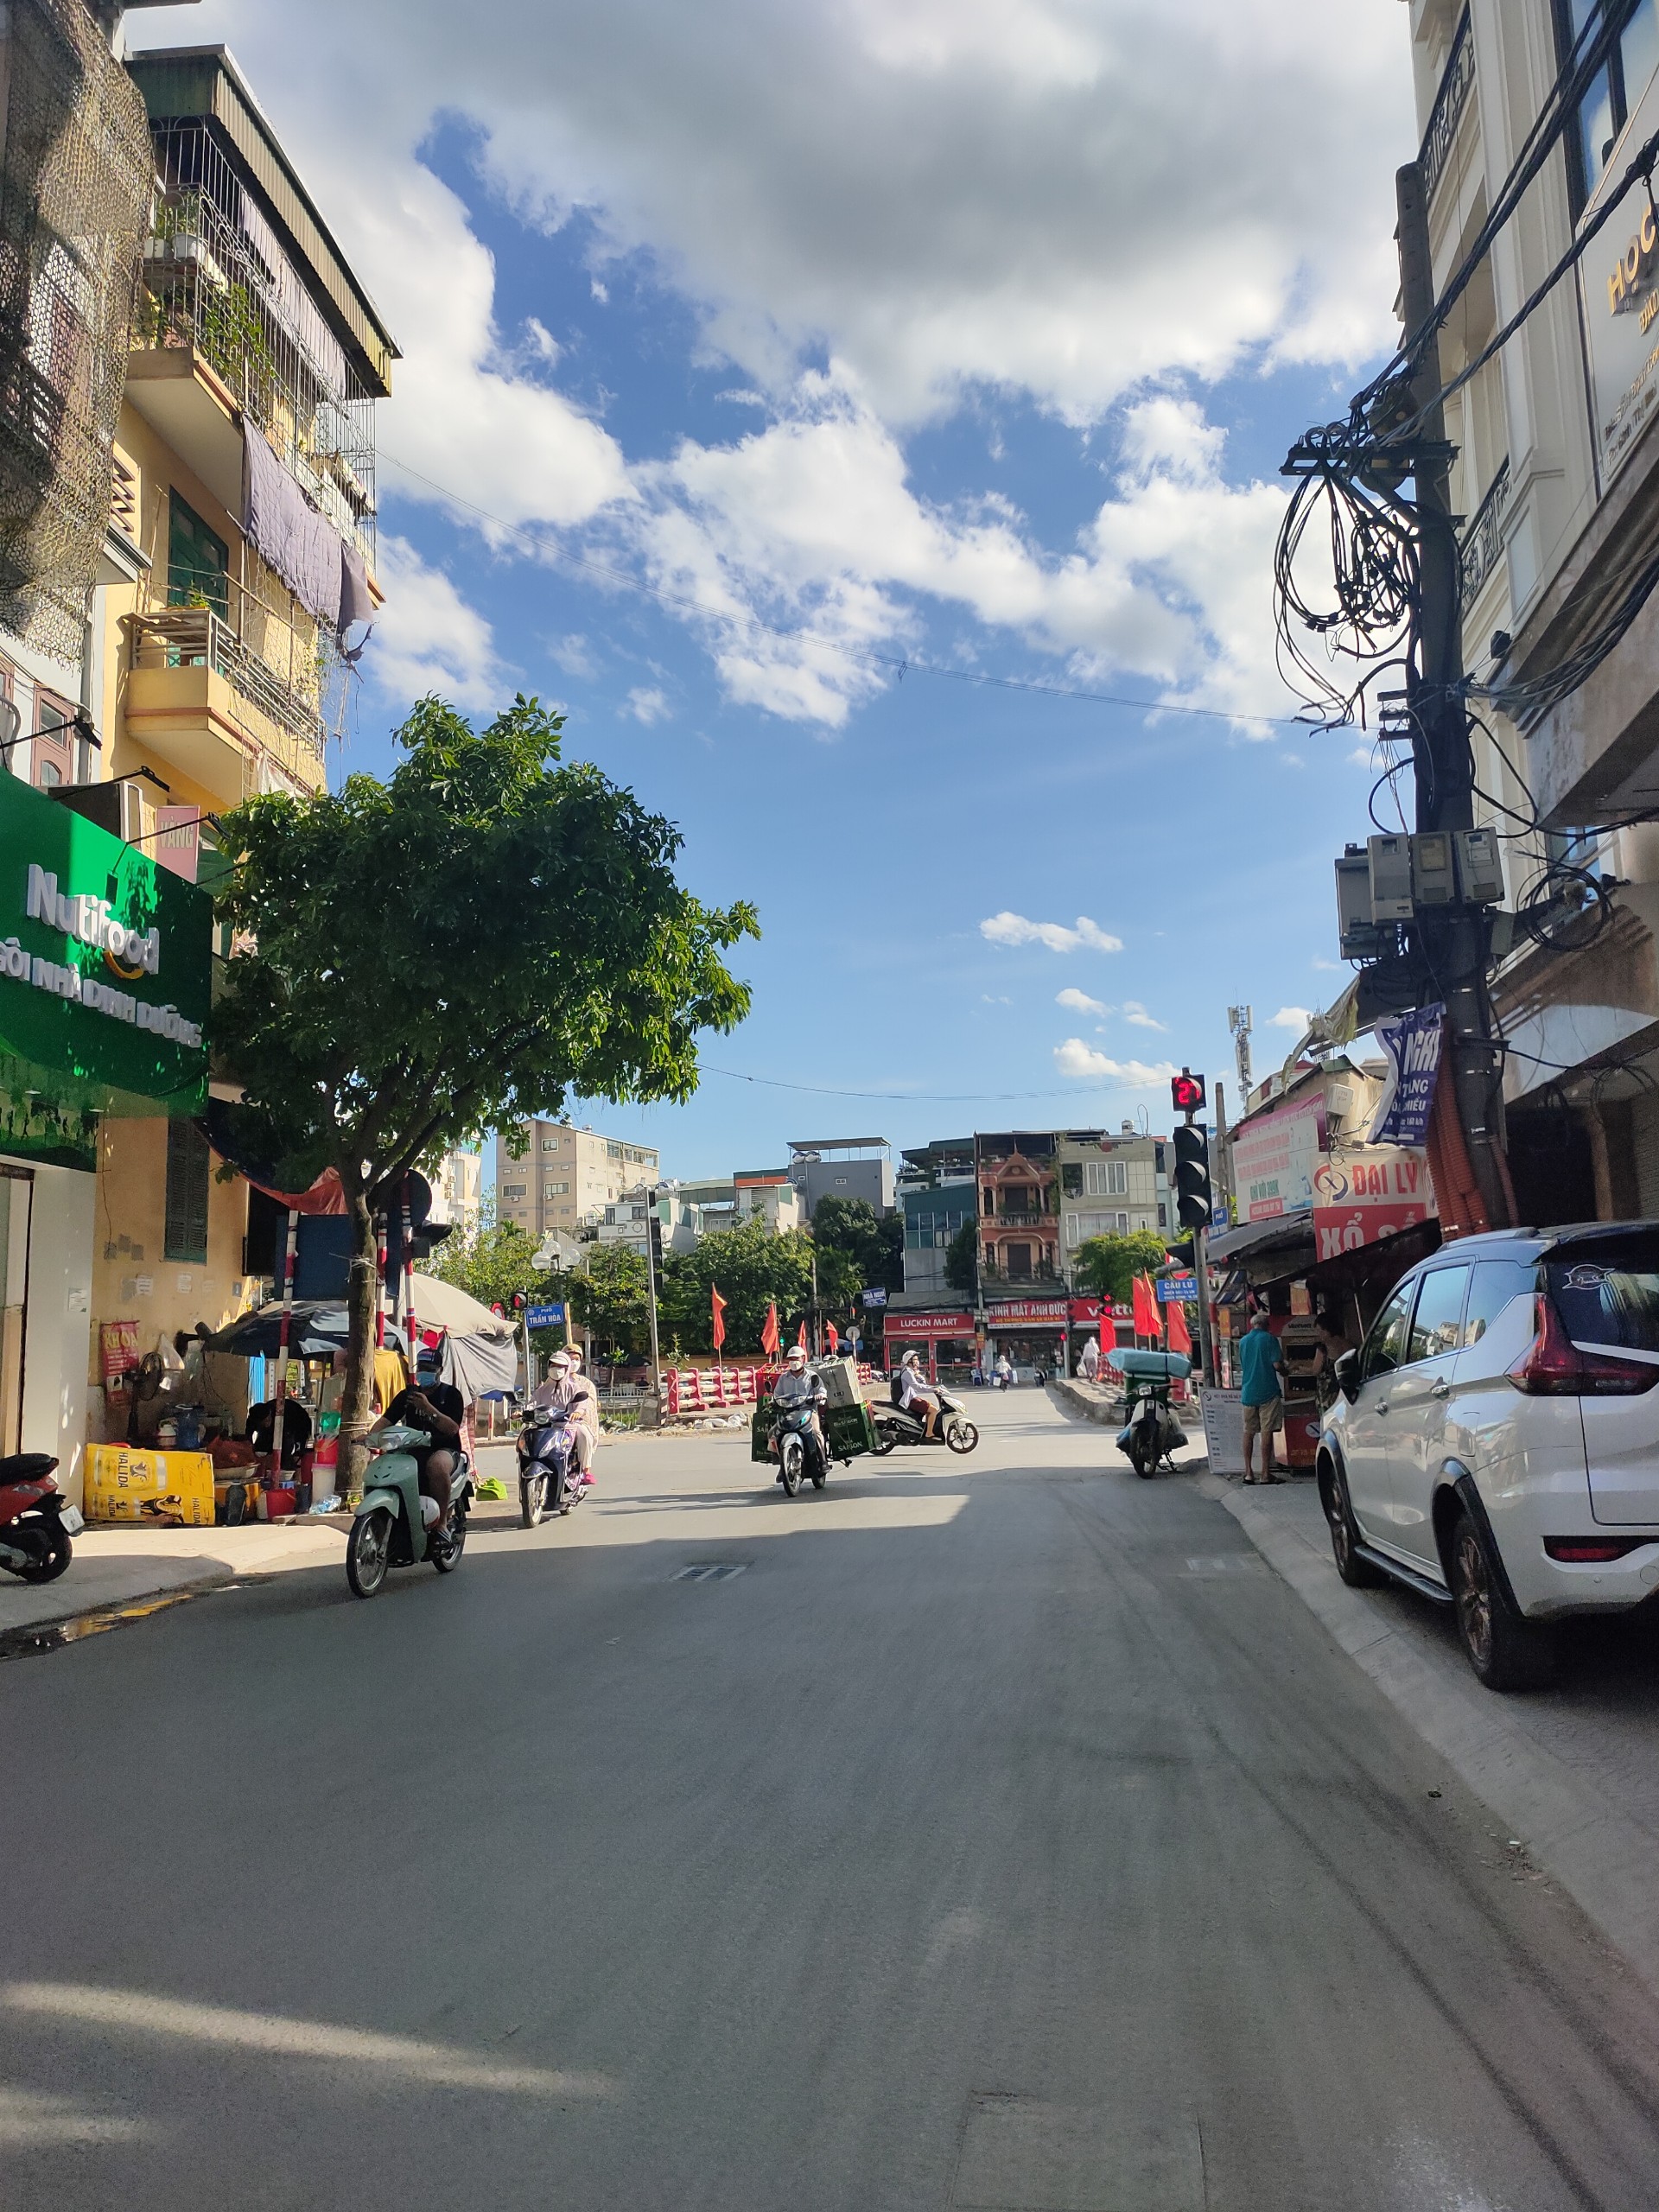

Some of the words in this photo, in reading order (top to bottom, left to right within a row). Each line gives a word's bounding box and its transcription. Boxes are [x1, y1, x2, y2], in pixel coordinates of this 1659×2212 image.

[1606, 203, 1656, 317] HỌC
[160, 815, 194, 849] VÀNG
[27, 863, 161, 976] Nutifood
[32, 957, 83, 1002] NHÀ
[83, 978, 137, 1023] DINH
[1352, 1164, 1389, 1202] ĐẠI
[1395, 1154, 1418, 1194] LÝ
[900, 1319, 931, 1328] LUCKIN
[933, 1318, 958, 1327] MART
[1030, 1304, 1048, 1317] ANH
[118, 1452, 129, 1488] HALIDA
[192, 1497, 202, 1525] HALIDA
